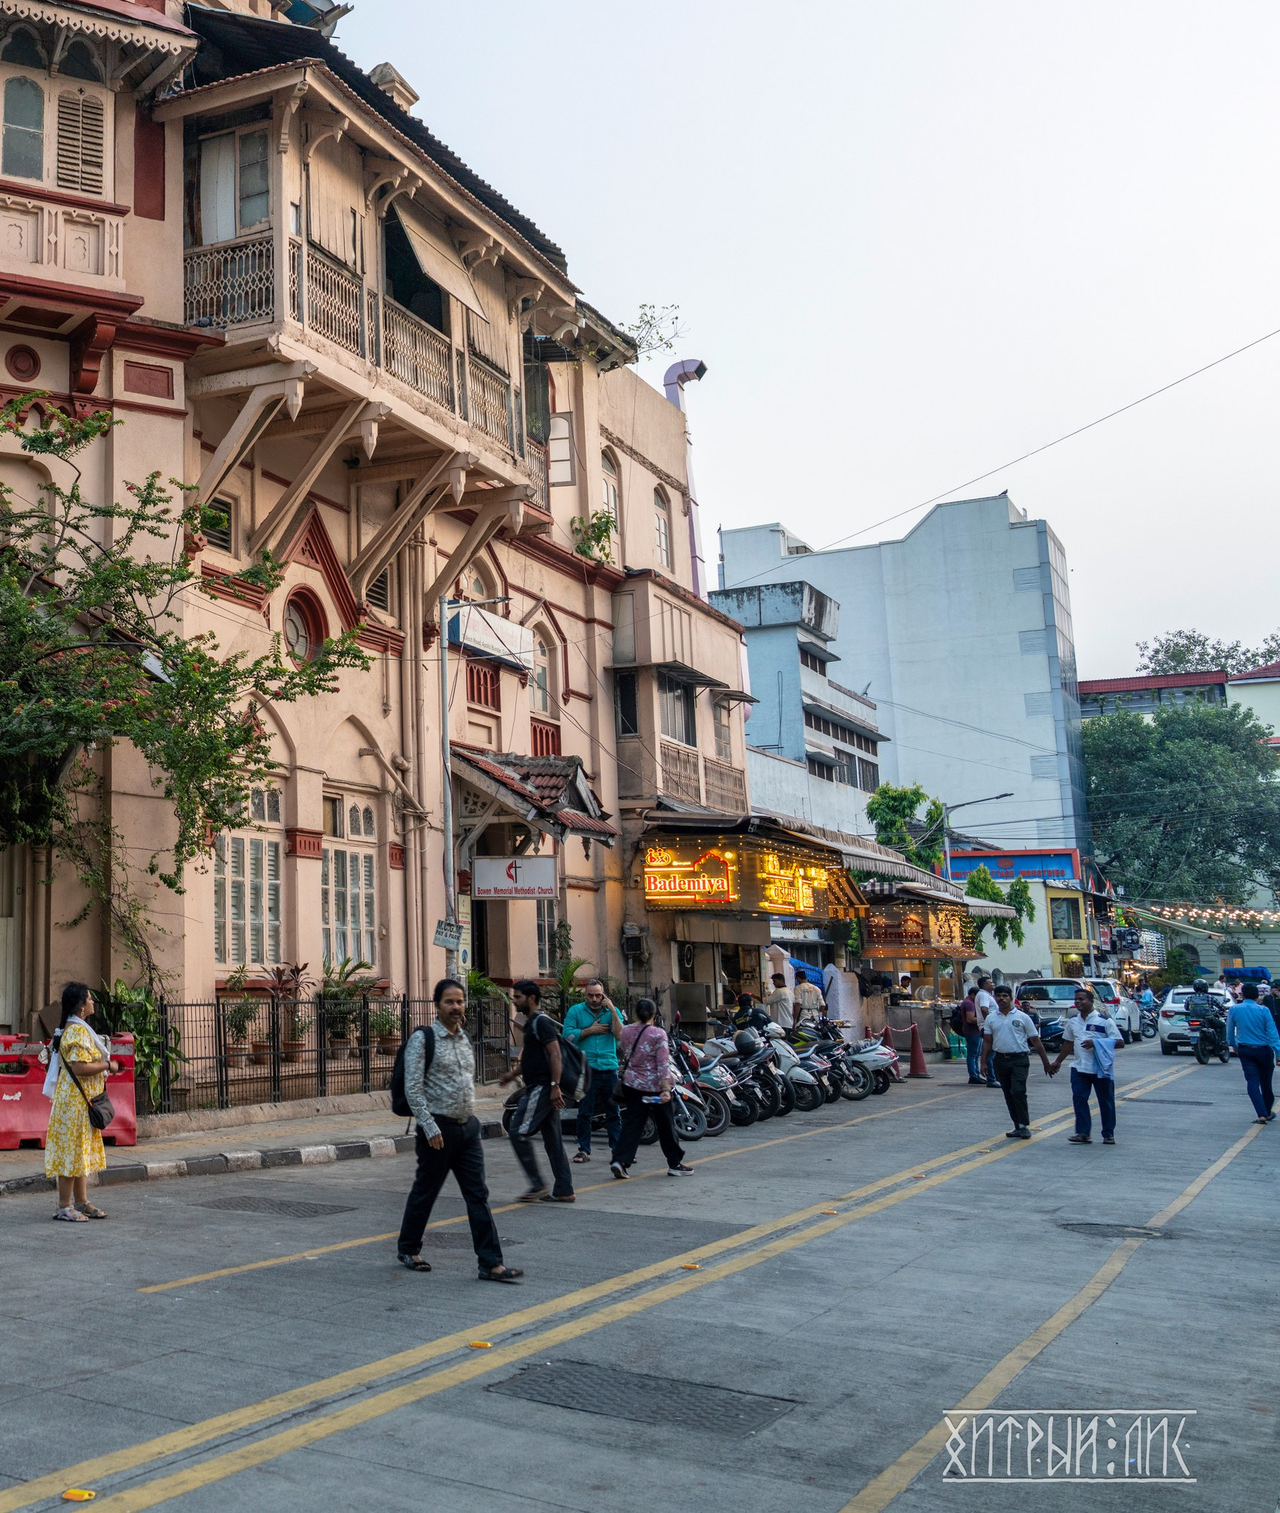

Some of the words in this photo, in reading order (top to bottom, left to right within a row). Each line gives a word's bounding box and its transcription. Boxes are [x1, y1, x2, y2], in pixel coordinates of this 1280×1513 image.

[1019, 868, 1066, 878] INDUSTRIES
[645, 873, 727, 894] Bademiya
[477, 887, 491, 895] Bowen
[493, 887, 513, 895] Memorial
[514, 887, 536, 895] Methodist
[537, 887, 553, 895] Church
